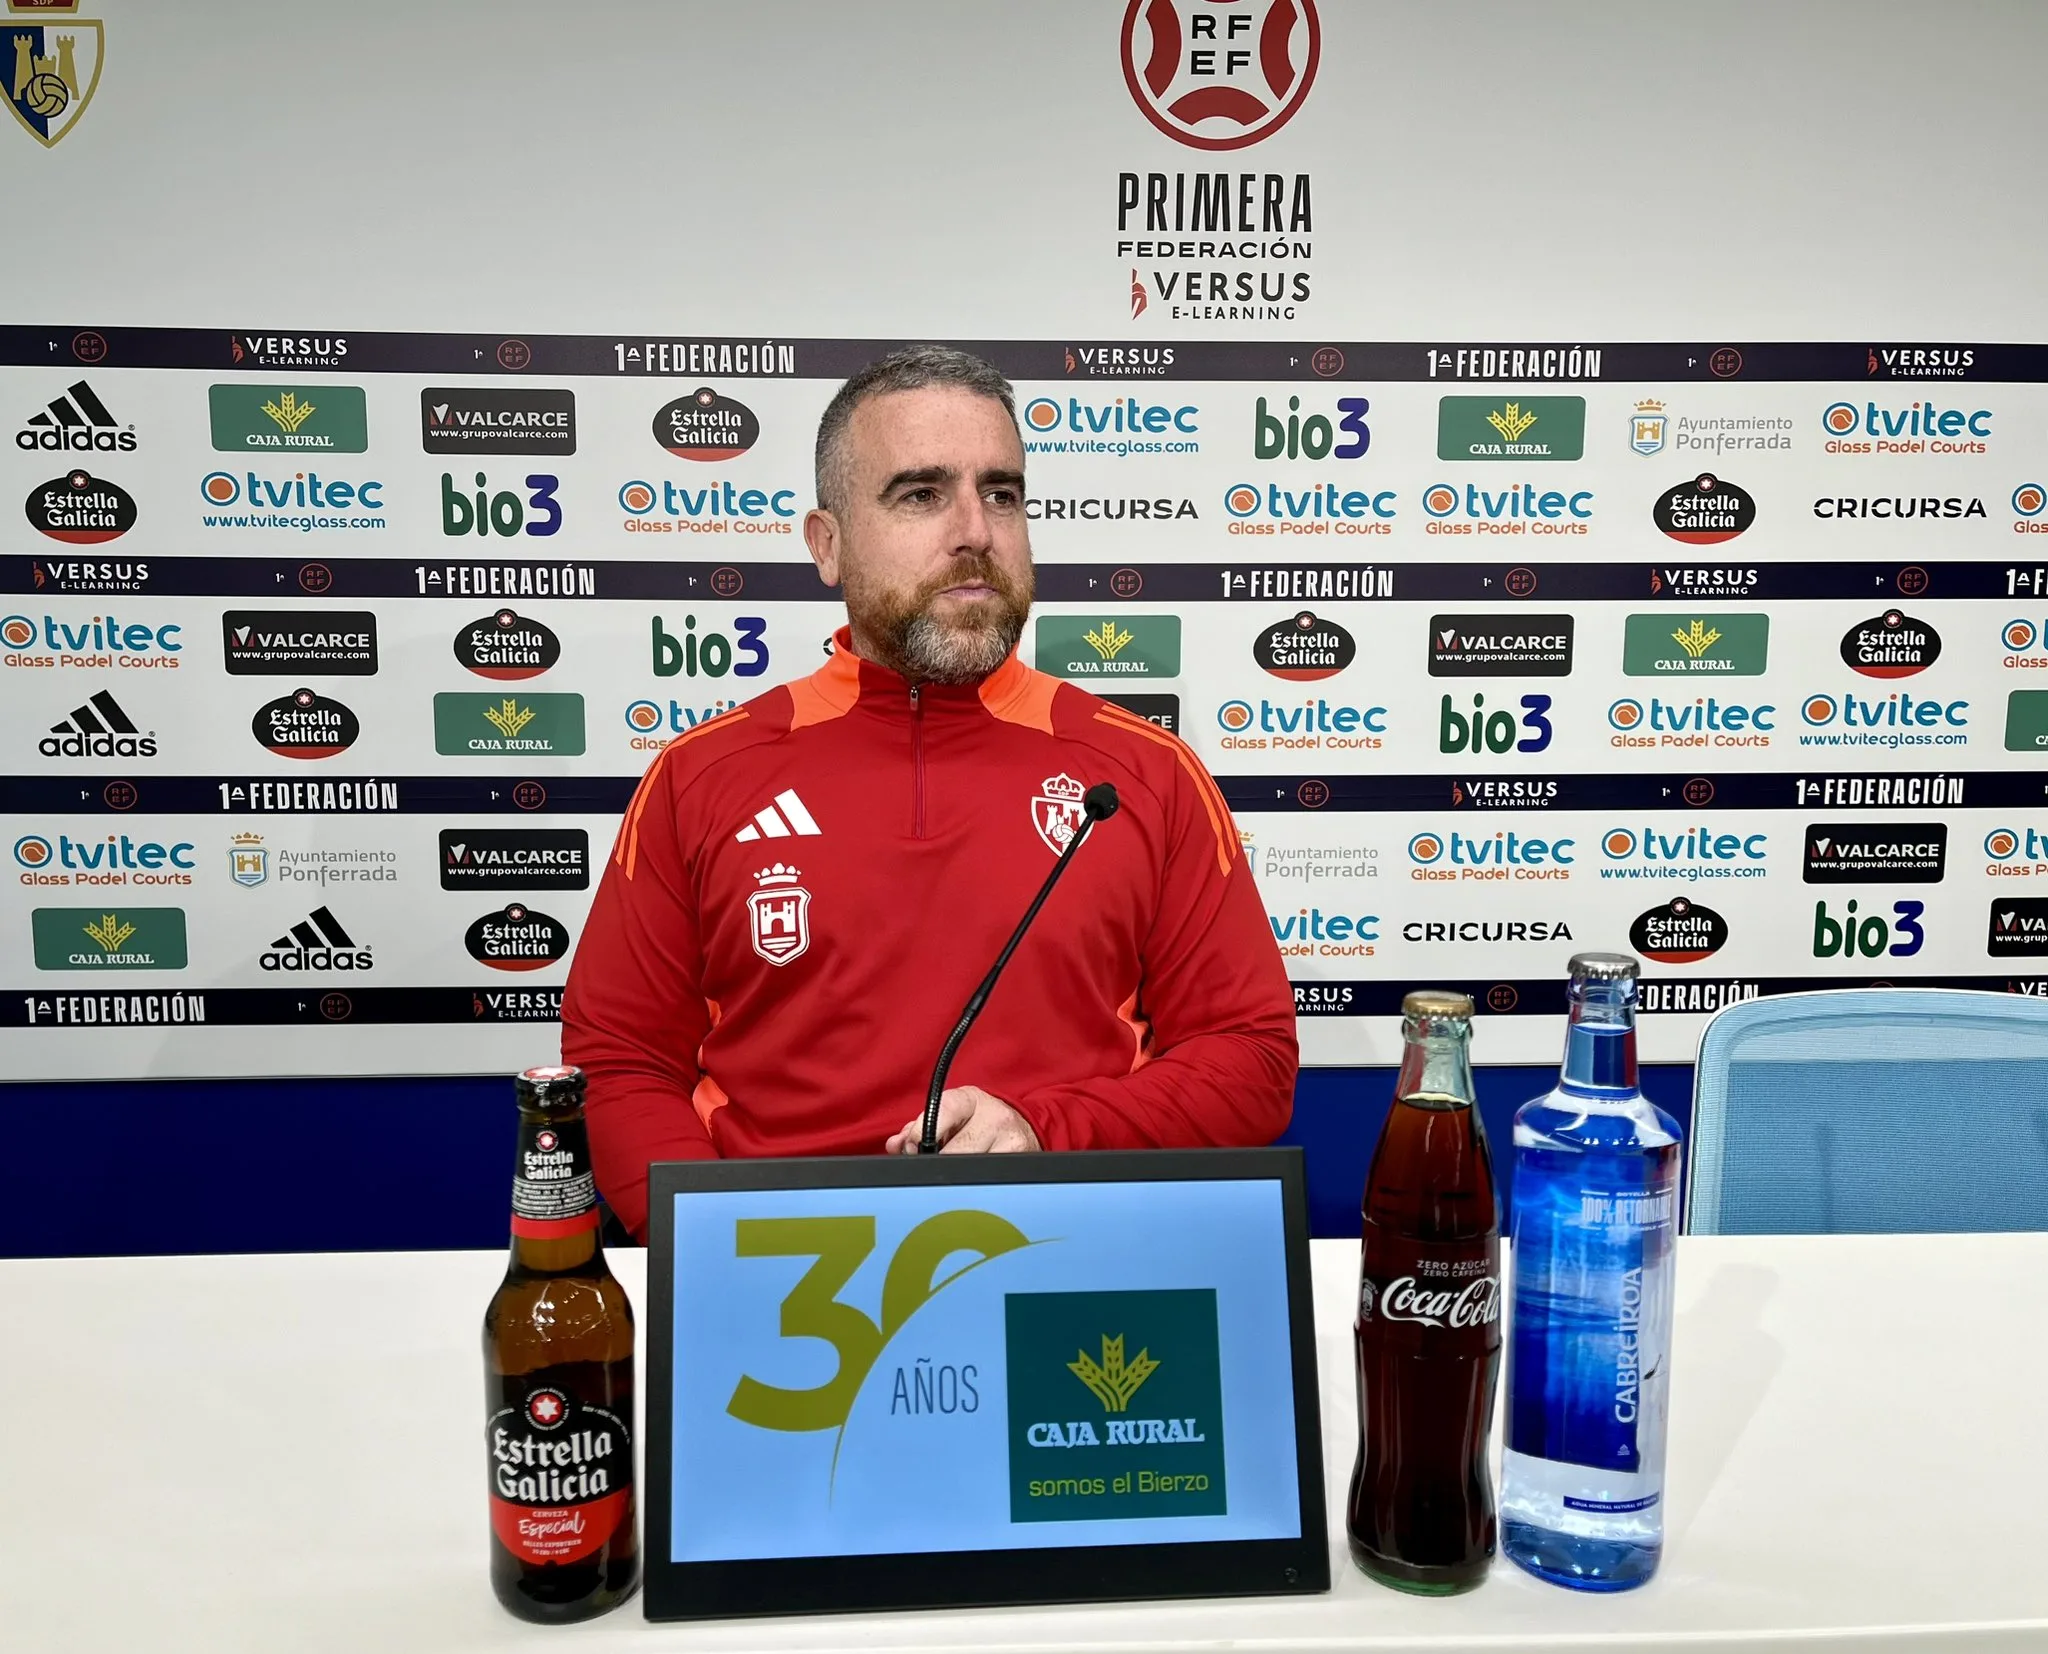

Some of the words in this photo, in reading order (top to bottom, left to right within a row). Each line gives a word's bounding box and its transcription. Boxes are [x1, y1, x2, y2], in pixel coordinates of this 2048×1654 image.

[1119, 173, 1311, 232] PRIMERA
[1118, 237, 1311, 258] FEDERACIÓN
[1154, 272, 1310, 301] VERSUS
[1173, 307, 1294, 319] E-LEARNING
[246, 338, 347, 355] VERSUS
[260, 357, 338, 365] E-LEARNING
[646, 341, 794, 373] FEDERACIÓN
[1079, 349, 1174, 364] VERSUS
[1457, 346, 1601, 377] FEDERACIÓN
[1882, 350, 1973, 366] VERSUS
[456, 412, 568, 426] VALCARCE
[670, 409, 741, 428] Estrella
[1070, 398, 1199, 433] tvitec
[1866, 402, 1992, 436] tvitec
[431, 429, 567, 439] www.grupovalcarce.com
[1255, 396, 1370, 460] bio3
[1678, 417, 1792, 434] Ayuntamiento
[246, 435, 282, 445] CAJA
[285, 436, 333, 446] RURAL
[673, 427, 738, 444] Galicia
[1677, 433, 1791, 455] Ponferrada
[1025, 440, 1198, 457] www.tvitecglass.com
[1470, 444, 1502, 454] CAJA
[1505, 445, 1551, 454] RURAL
[1825, 440, 1871, 453] Glass
[1877, 440, 1925, 453] Padel
[1931, 441, 1985, 453] Courts
[248, 472, 383, 508] tvitec
[664, 481, 795, 516] tvitec
[44, 492, 118, 510] Estrella
[442, 472, 562, 537] bio3
[1025, 499, 1198, 519] CRICURSA
[1269, 484, 1397, 518] tvitec
[1467, 484, 1593, 518] tvitec
[1670, 495, 1739, 513] Estrella
[1814, 498, 1986, 518] CRICURSA
[48, 509, 116, 526] Galicia
[203, 514, 385, 532] www.tvitecglass.com
[624, 519, 672, 532] Glass
[678, 520, 727, 532] Padel
[734, 521, 791, 533] Courts
[1672, 511, 1734, 527] Galicia
[1228, 521, 1274, 534] Glass
[1281, 521, 1328, 534] Padel
[1335, 522, 1391, 534] Courts
[1426, 521, 1472, 534] Glass
[1478, 521, 1525, 534] Padel
[1532, 522, 1587, 534] Courts
[47, 563, 148, 580] VERSUS
[447, 564, 594, 595] FEDERACIÓN
[1665, 570, 1757, 585] VERSUS
[1251, 566, 1393, 597] FEDERACIÓN
[44, 616, 182, 651] tvitec
[258, 634, 369, 647] VALCARCE
[471, 630, 542, 648] Estrella
[1270, 632, 1338, 650] Estrella
[1857, 630, 1925, 645] Estrella
[652, 615, 769, 677] bio3
[1461, 636, 1566, 649] VALCARCE
[4, 654, 54, 667] Glass
[61, 654, 112, 667] Padel
[119, 656, 178, 668] Courts
[233, 651, 369, 660] www.grupovalcarce.com
[474, 647, 539, 663] Galicia
[1273, 649, 1335, 665] Galicia
[1436, 653, 1565, 662] www.grupovalcarce.com
[1859, 647, 1920, 662] Galicia
[1067, 662, 1100, 672] CAJA
[1103, 662, 1148, 672] RURAL
[1655, 660, 1686, 670] CAJA
[1690, 660, 1735, 670] RURAL
[270, 709, 341, 727] Estrella
[1261, 700, 1387, 733] tvitec
[1651, 698, 1776, 731] tvitec
[1844, 694, 1969, 726] tvitec
[1440, 693, 1552, 754] bio3
[273, 726, 338, 742] Galicia
[1221, 736, 1267, 749] Glass
[1273, 736, 1320, 748] Padel
[1326, 737, 1381, 748] Courts
[1611, 735, 1656, 747] Glass
[1662, 734, 1708, 746] Padel
[1714, 735, 1769, 746] Courts
[1800, 733, 1967, 748] www.tvitecglass.com
[469, 740, 502, 750] CAJA
[506, 740, 552, 749] RURAL
[250, 779, 397, 809] FEDERACIÓN
[1466, 782, 1557, 797] VERSUS
[1824, 774, 1963, 804] FEDERACIÓN
[1451, 832, 1575, 864] tvitec
[1644, 828, 1767, 859] tvitec
[1836, 844, 1939, 857] VALCARCE
[60, 836, 195, 869] tvitec
[280, 850, 395, 865] Ayuntamiento
[473, 850, 581, 863] VALCARCE
[1267, 847, 1378, 862] Ayuntamiento
[448, 867, 581, 876] www.grupovalcarce.com
[1266, 862, 1377, 883] Ponferrada
[1600, 866, 1766, 881] www.tvitecglass.com
[1811, 860, 1937, 870] www.grupovalcarce.com
[1986, 863, 2030, 876] Glass
[20, 872, 70, 885] Glass
[76, 872, 126, 885] Padel
[133, 873, 192, 884] Courts
[280, 866, 397, 887] Ponferrada
[1411, 868, 1456, 880] Glass
[1462, 868, 1509, 880] Padel
[1515, 868, 1569, 879] Courts
[482, 924, 551, 941] Estrella
[1403, 922, 1572, 941] CRICURSA
[1646, 917, 1712, 935] Estrella
[1813, 899, 1924, 958] bio3
[485, 938, 549, 955] Galicia
[1648, 931, 1708, 948] Galicia
[69, 954, 103, 964] CAJA
[107, 954, 154, 964] RURAL
[1320, 945, 1374, 956] Courts
[56, 993, 205, 1022] FEDERACIÓN
[523, 1151, 574, 1165] Estrella
[524, 1165, 573, 1180] Galicia
[1416, 1259, 1449, 1270] ZERO
[1423, 1269, 1449, 1277] ZERO
[891, 1358, 978, 1415] AÑOS
[1027, 1422, 1100, 1448] CAJA
[1106, 1419, 1205, 1445] RURAL
[493, 1427, 613, 1467] Estrella
[497, 1463, 609, 1503] Galicia
[1030, 1479, 1105, 1496] somos
[1113, 1472, 1130, 1493] el
[1139, 1471, 1208, 1492] Bierzo
[518, 1511, 586, 1539] Especial
